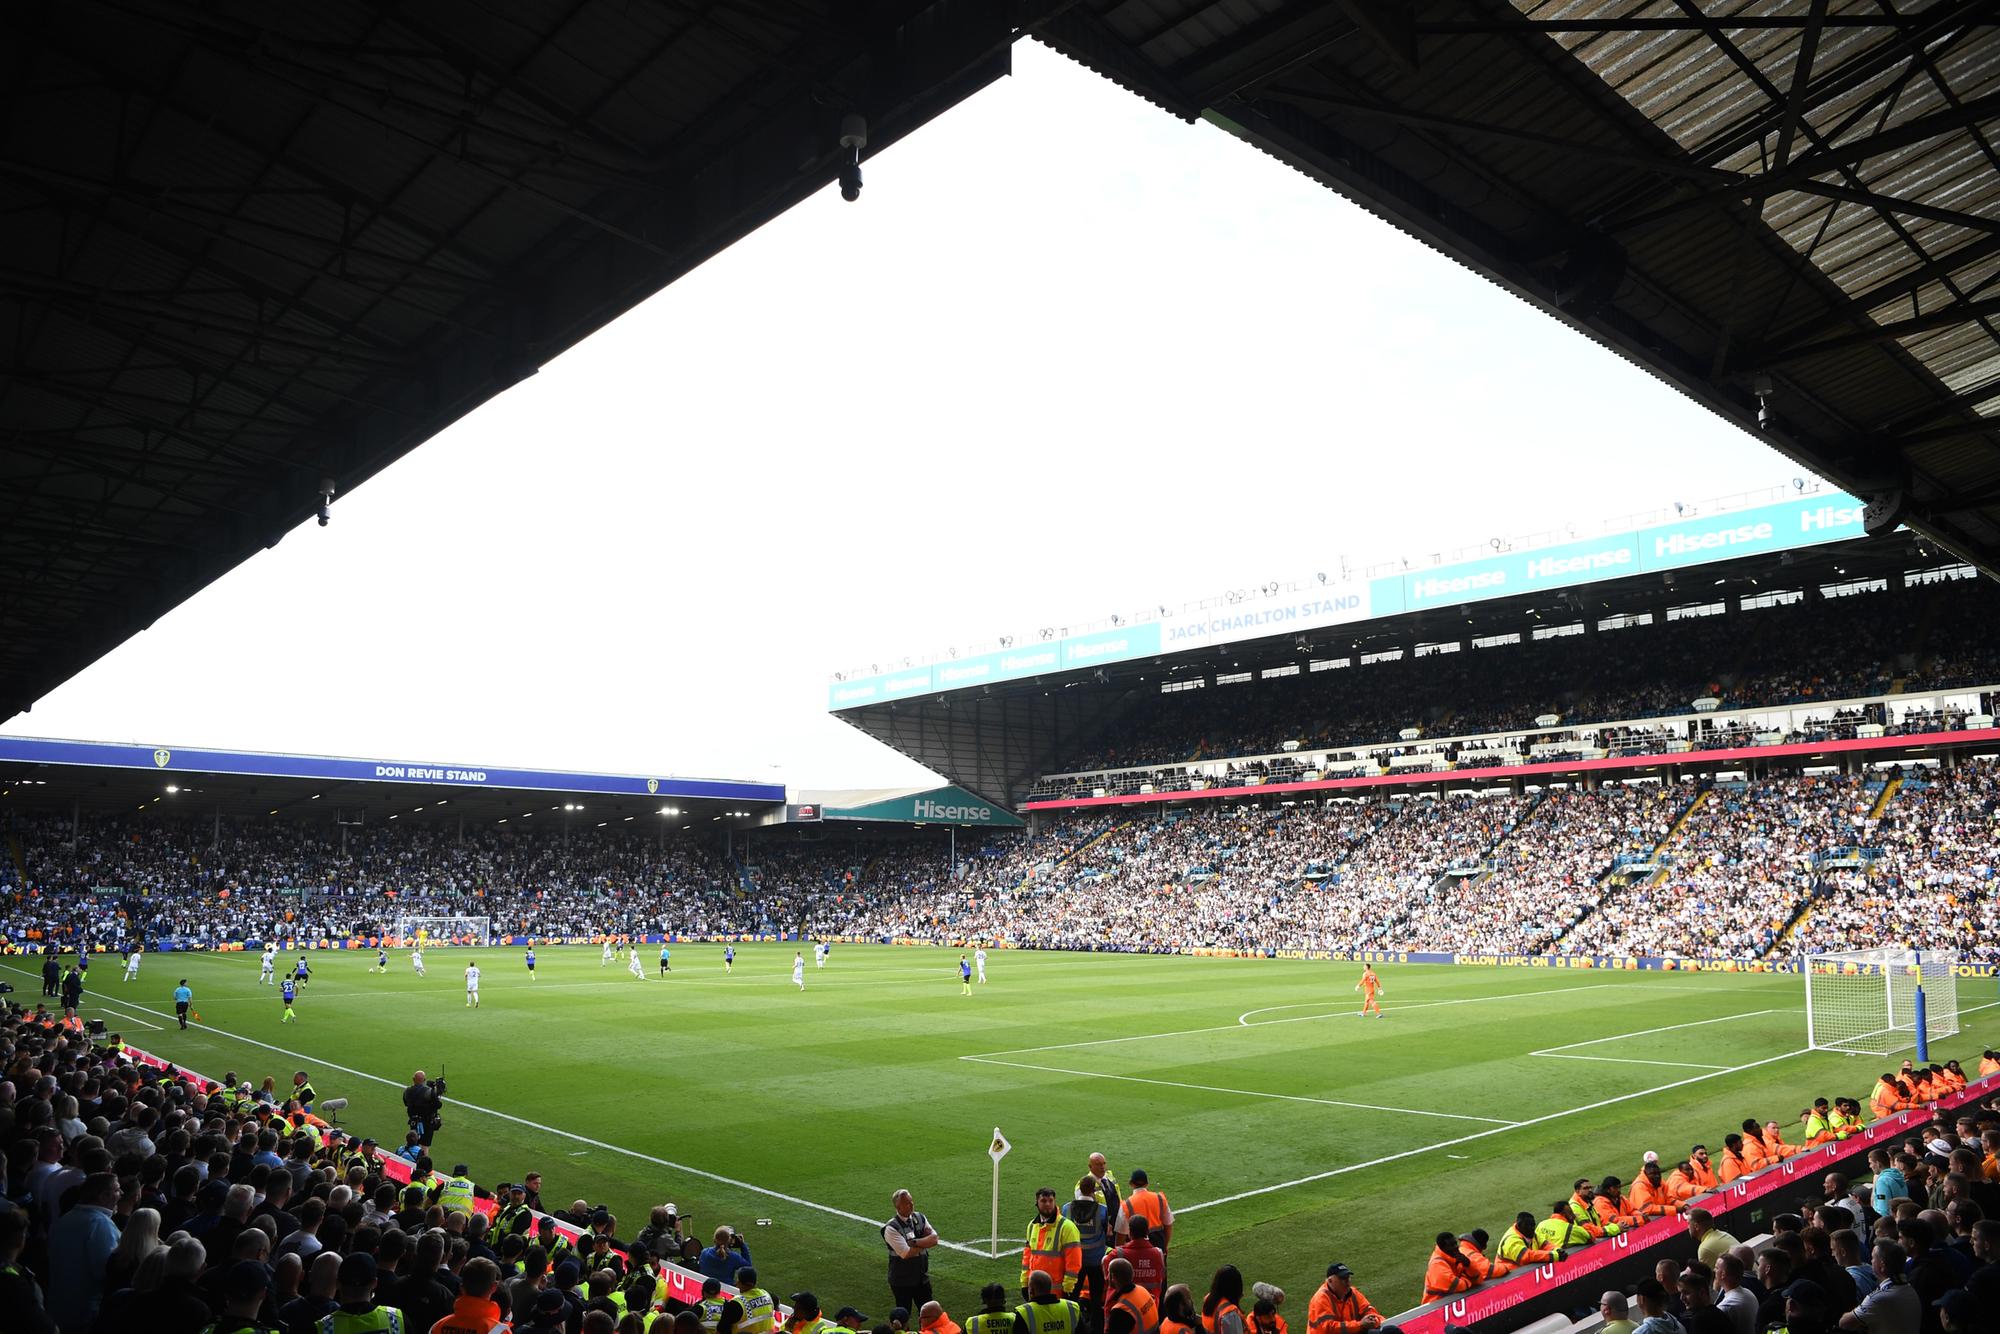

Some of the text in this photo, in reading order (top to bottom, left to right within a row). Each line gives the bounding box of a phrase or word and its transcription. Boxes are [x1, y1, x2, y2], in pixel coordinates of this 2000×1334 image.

[1801, 506, 1864, 532] Hise
[1656, 524, 1772, 557] Hisense
[1528, 549, 1630, 578] Hisense
[1415, 571, 1505, 598] Hisense
[1169, 595, 1360, 640] JACK CHARLTON STAND
[1068, 639, 1128, 660] Hisense
[376, 766, 486, 781] DON REVIE STAND
[914, 799, 991, 820] Hisense
[1276, 949, 1306, 959] OLLOW
[1308, 950, 1331, 960] LUFC
[1460, 955, 1549, 967] OLLOW LUFC ON
[1138, 1259, 1150, 1268] FIRE
[1467, 1291, 1525, 1327] mortgages
[986, 1318, 1011, 1328] SENIOR
[1043, 1320, 1065, 1332] SENIOR
